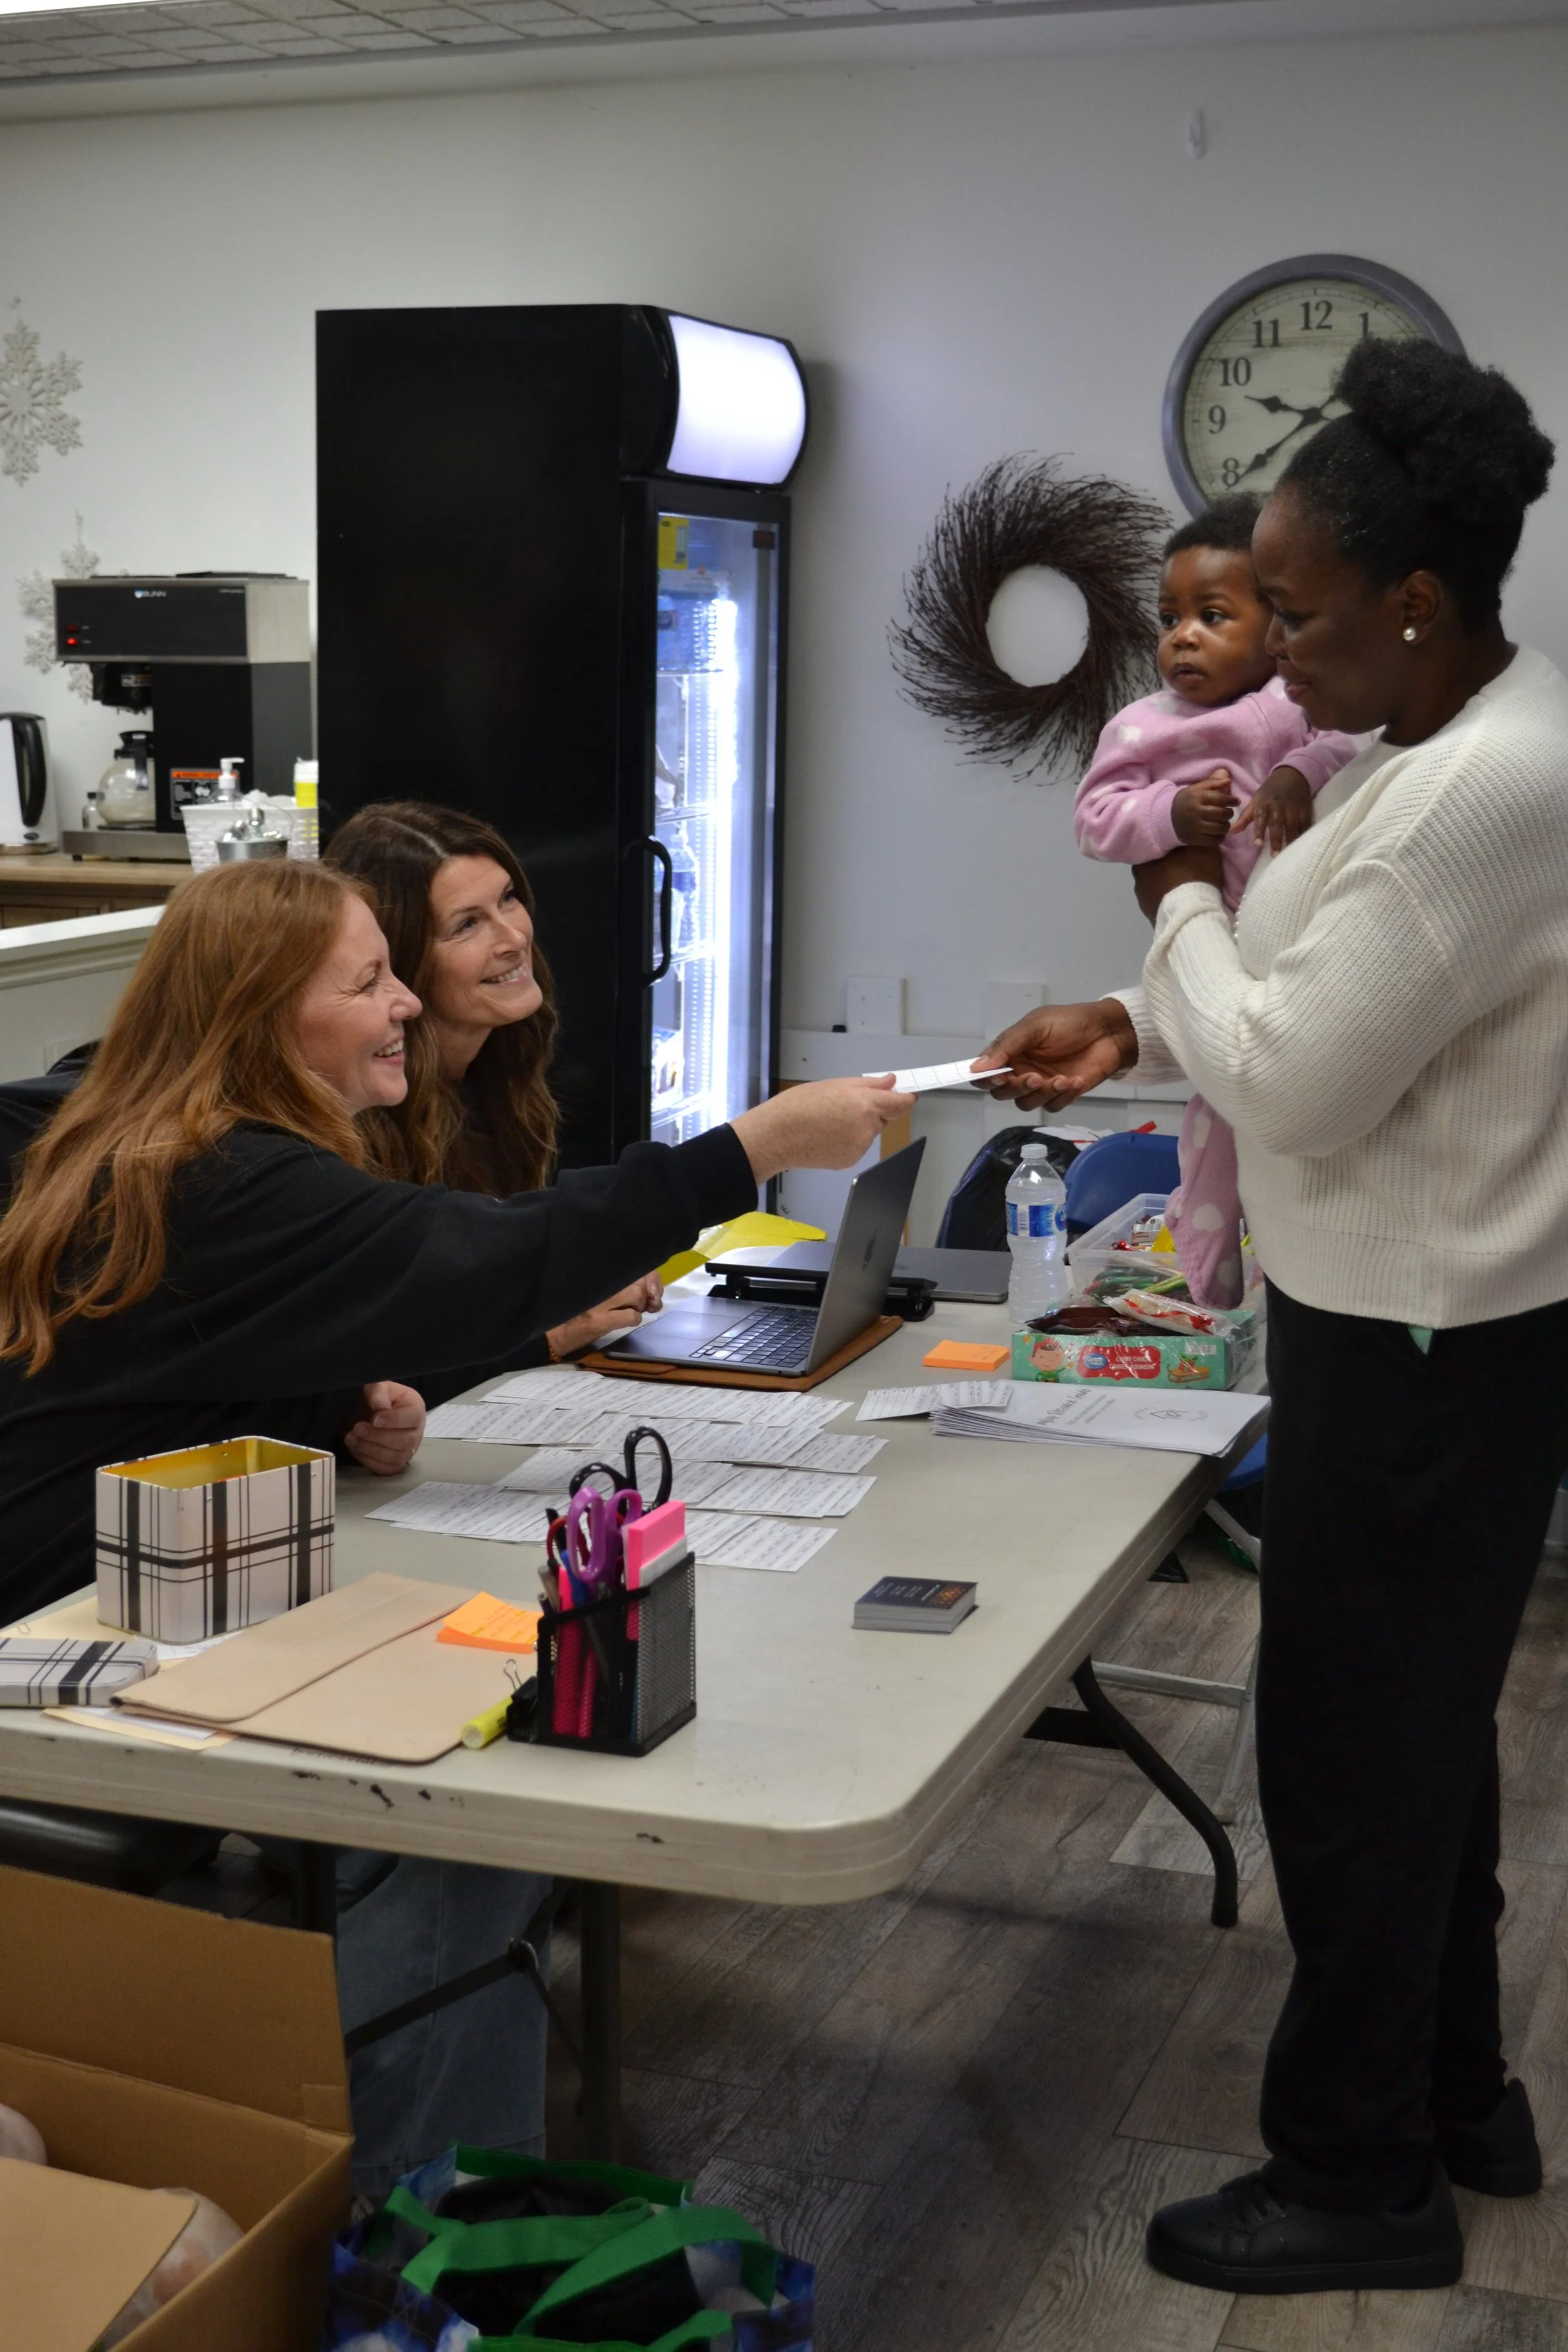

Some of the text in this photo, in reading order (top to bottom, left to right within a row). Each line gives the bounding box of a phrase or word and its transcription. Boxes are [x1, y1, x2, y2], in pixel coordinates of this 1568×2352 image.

[1300, 300, 1333, 331] 12
[1253, 319, 1280, 349] 11
[1219, 357, 1252, 387] 10
[1208, 405, 1226, 434] 9
[1222, 458, 1240, 488] 8
